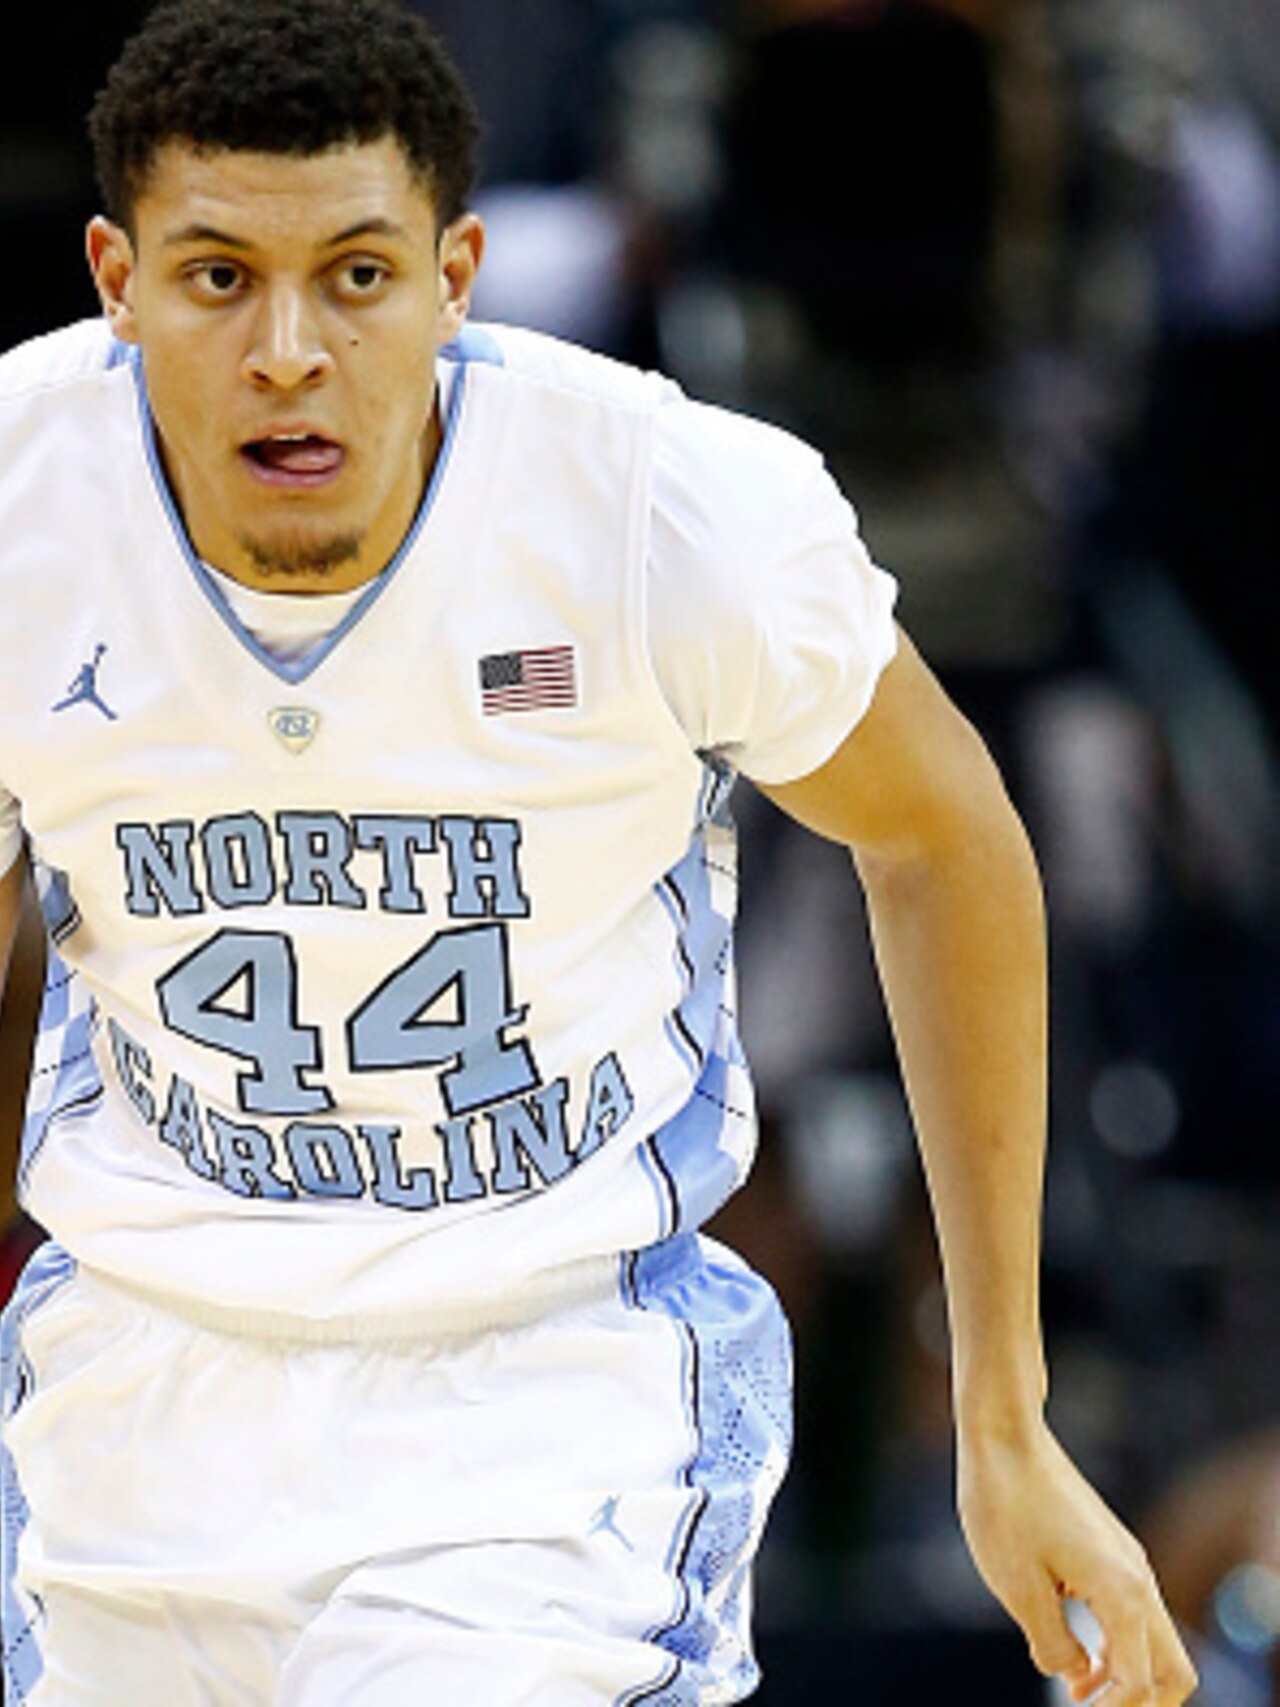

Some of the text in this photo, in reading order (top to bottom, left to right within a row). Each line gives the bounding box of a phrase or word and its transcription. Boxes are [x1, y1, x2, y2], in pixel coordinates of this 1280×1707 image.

[117, 811, 531, 917] NORTH
[107, 1016, 634, 1211] CAROLINA
[155, 922, 542, 1115] 44
